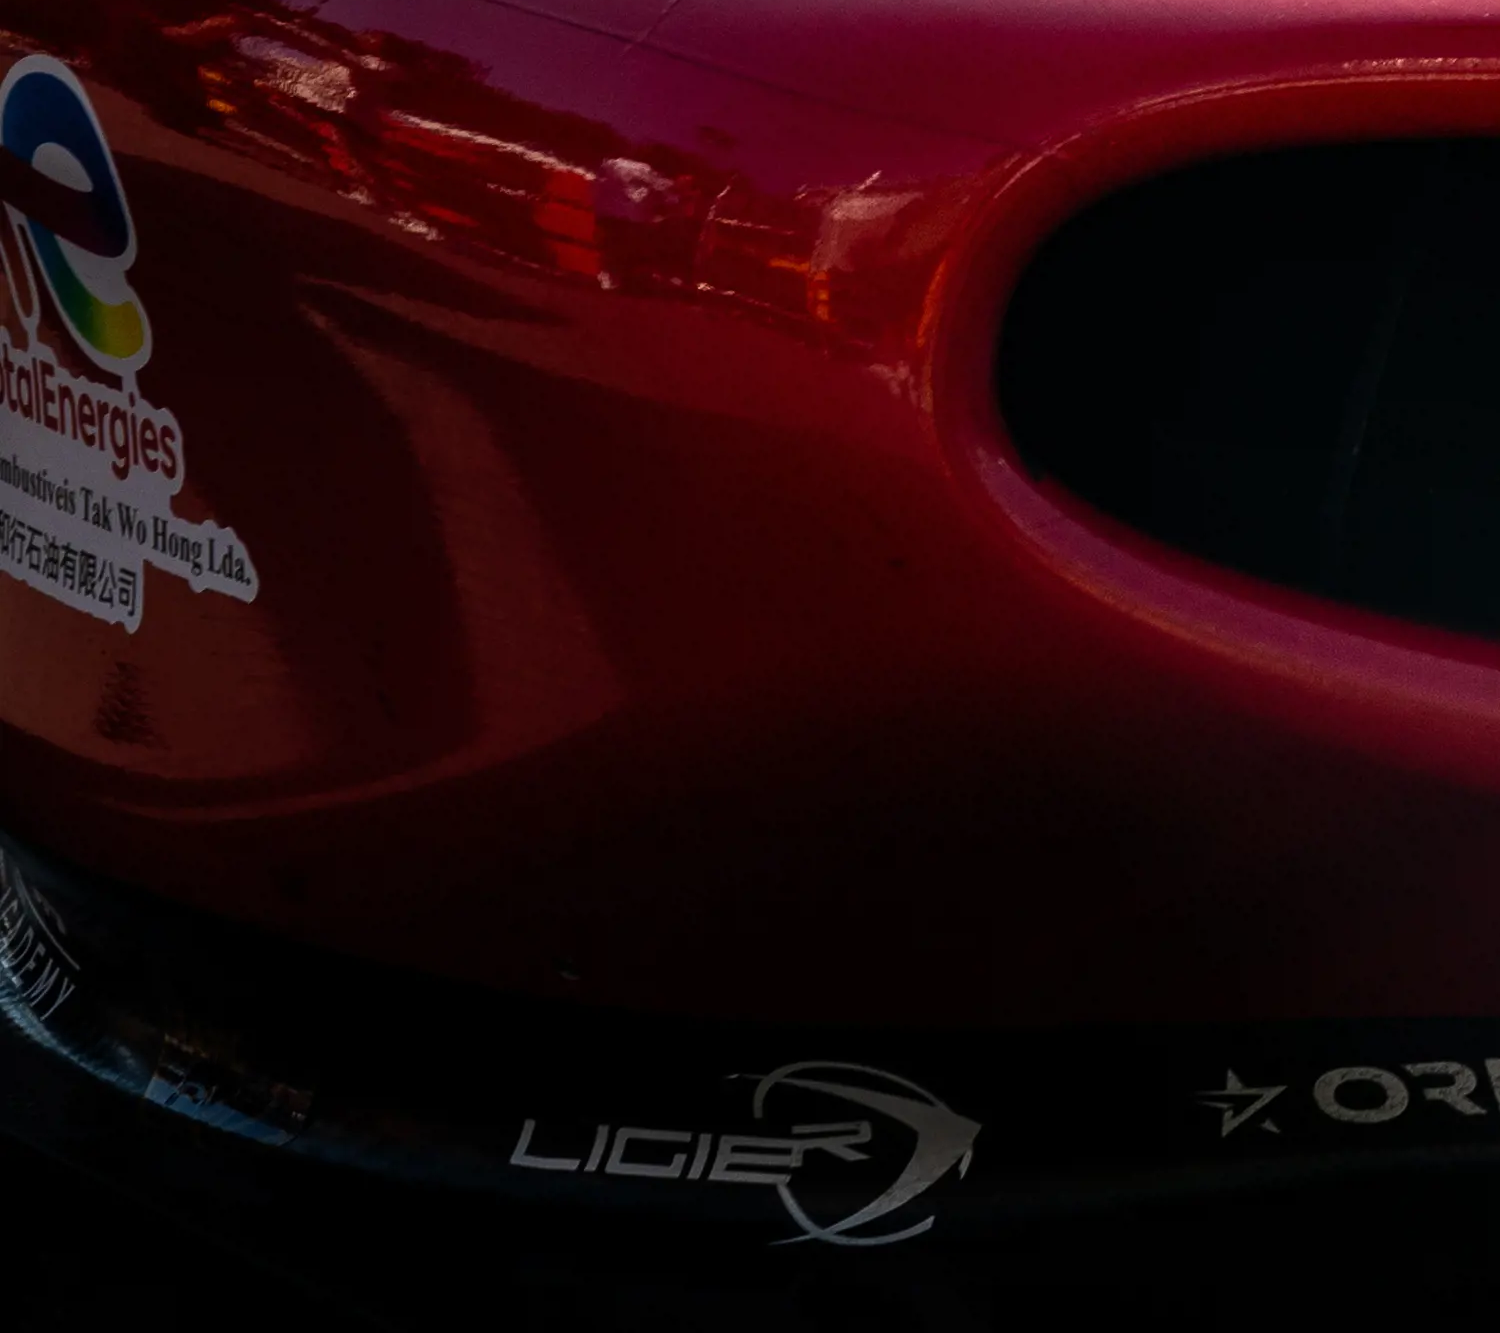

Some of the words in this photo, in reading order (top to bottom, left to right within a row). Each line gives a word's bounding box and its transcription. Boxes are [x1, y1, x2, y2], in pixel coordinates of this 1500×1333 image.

[80, 486, 112, 533] Tak
[117, 502, 147, 545] Wo
[152, 516, 203, 576] Hong
[207, 538, 252, 587] Lda.
[508, 1116, 874, 1186] LIGIER
